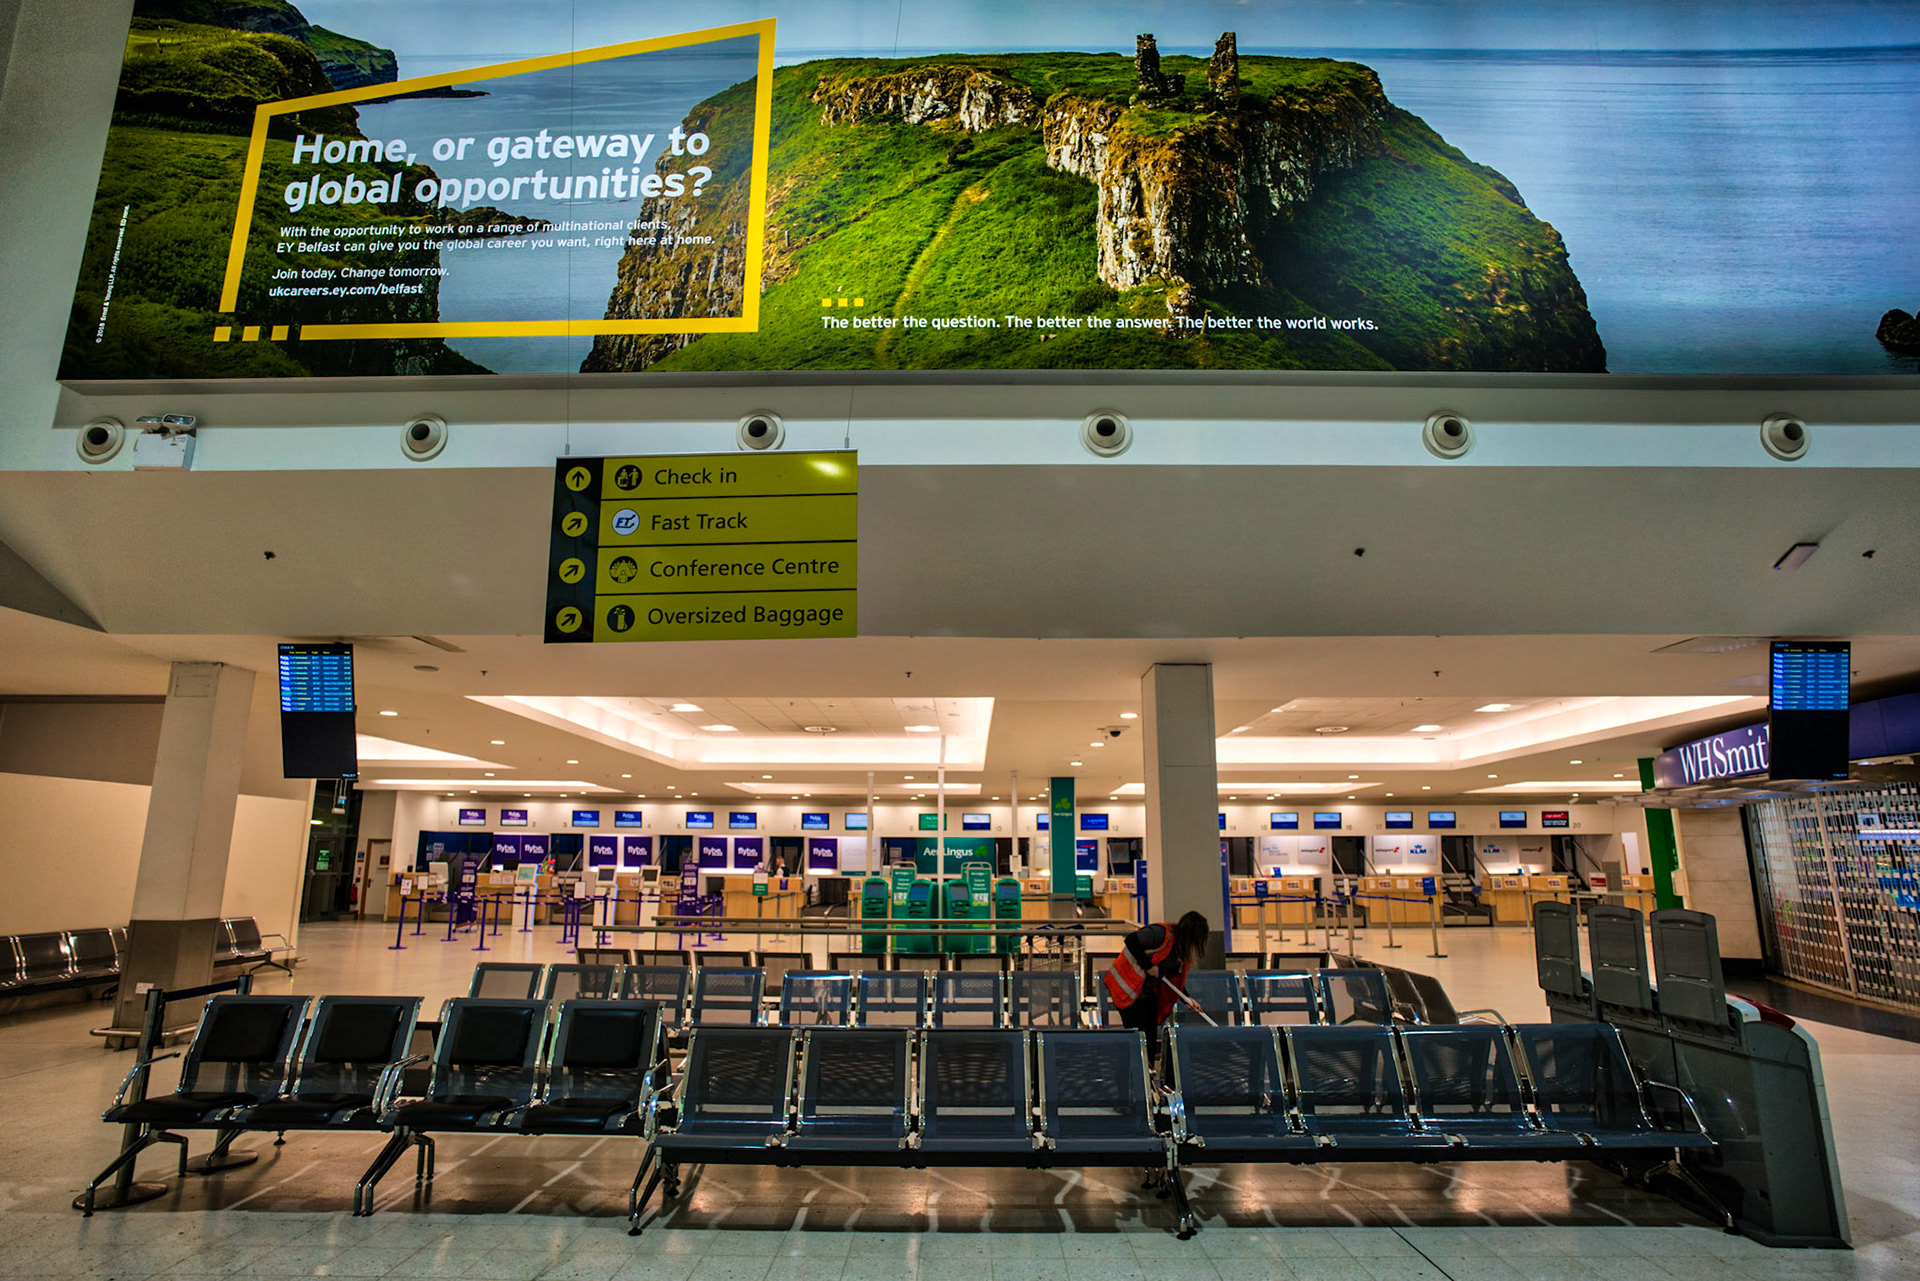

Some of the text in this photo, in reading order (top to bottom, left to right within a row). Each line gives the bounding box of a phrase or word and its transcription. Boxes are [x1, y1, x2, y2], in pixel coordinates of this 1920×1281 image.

[292, 126, 710, 167] Home, or gateway to
[284, 166, 713, 213] global opportunities?
[280, 219, 672, 238] With the opportunity to work on a range of multinational clients,
[277, 235, 716, 253] EY Belfast can give you the global career you want, right here at home.
[272, 266, 450, 280] Join today. Change tomorrow.
[269, 283, 424, 297] ukcareers.ey.com/belfast
[821, 315, 1379, 330] The better the question. The better the answer. The better the world works.
[654, 467, 738, 485] Check in
[651, 512, 748, 531] Fast Track
[650, 558, 840, 578] Conference Centre
[648, 605, 844, 626] Oversized Baggage
[923, 847, 938, 856] Ae
